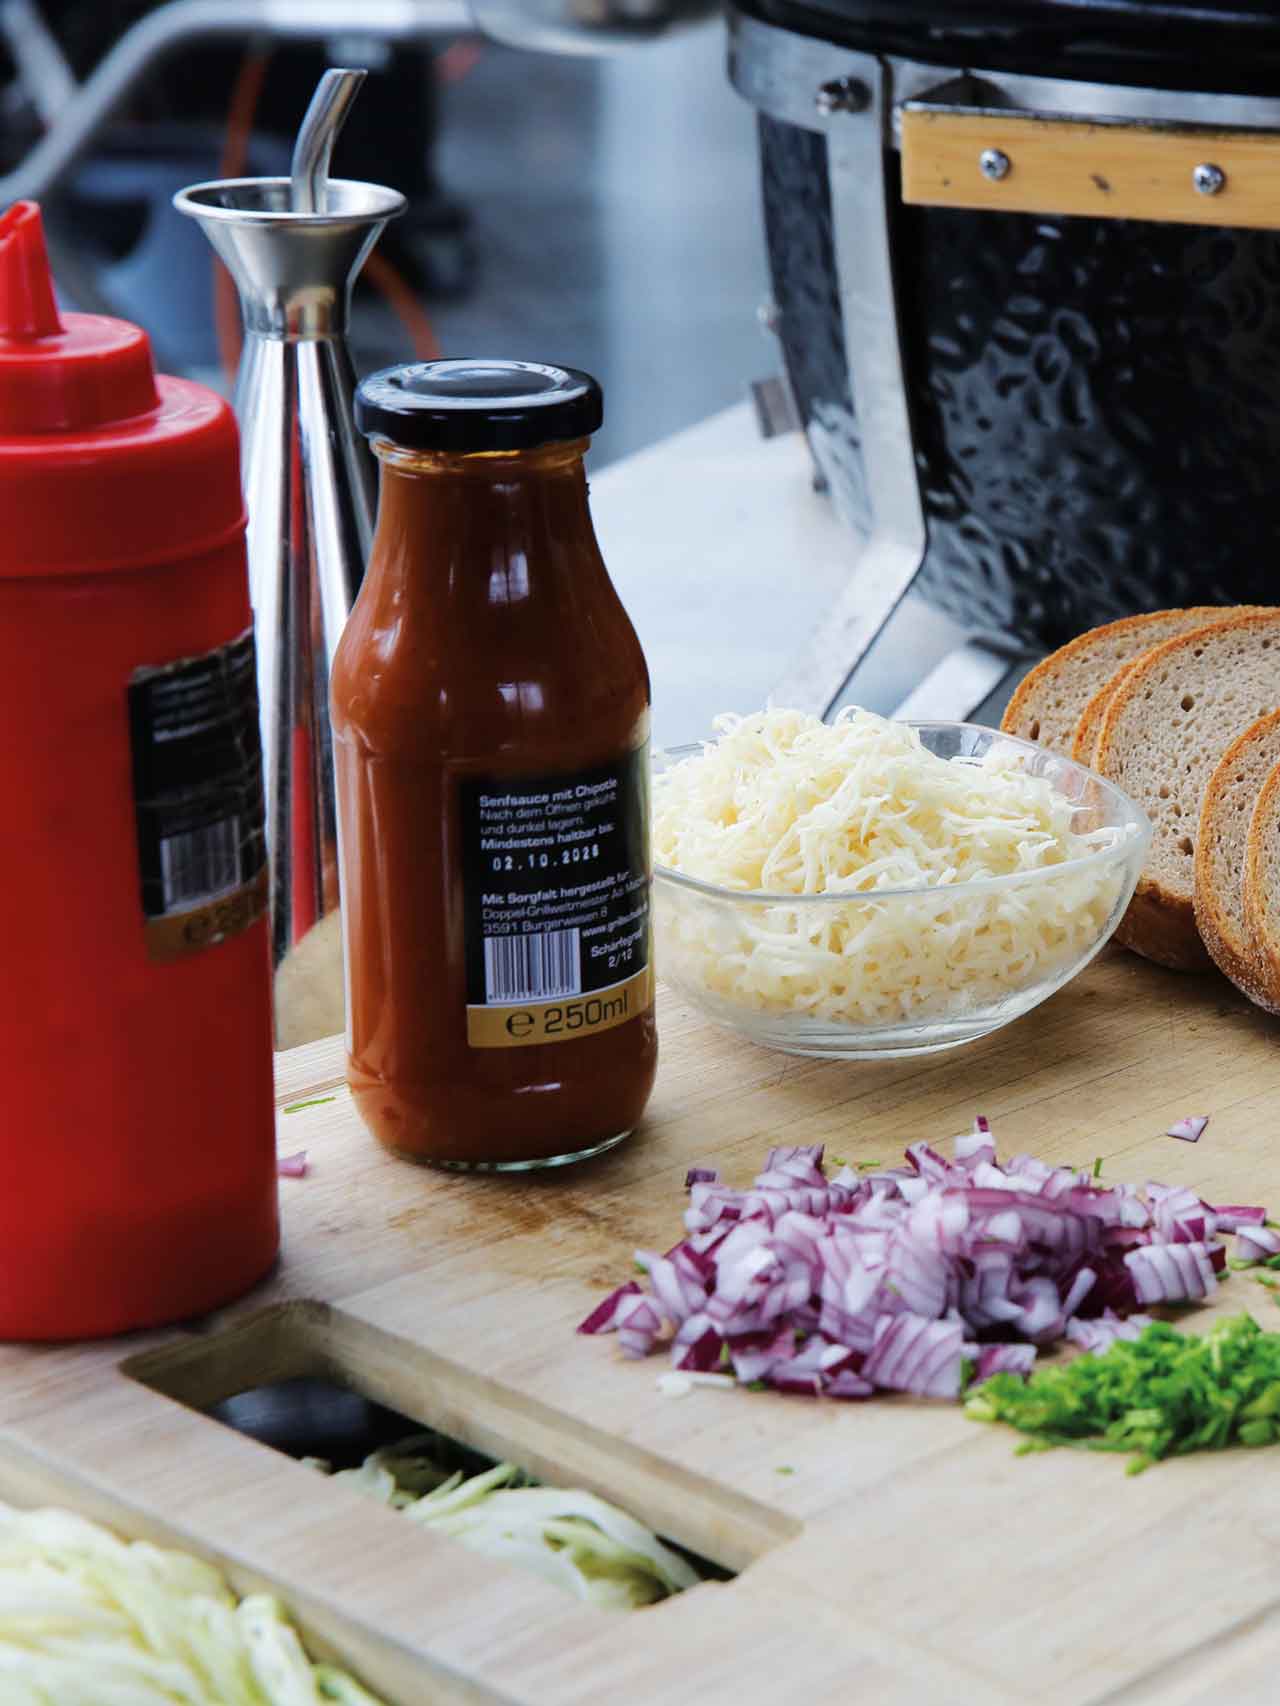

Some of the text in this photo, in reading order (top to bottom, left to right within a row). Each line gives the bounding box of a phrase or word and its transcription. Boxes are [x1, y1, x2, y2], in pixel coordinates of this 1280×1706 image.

[552, 790, 573, 802] mit
[480, 808, 512, 820] Nach
[516, 806, 542, 818] dem
[481, 823, 503, 835] und
[507, 820, 545, 834] dunkel
[481, 836, 554, 850] Mindestens
[557, 826, 596, 843] haltbar
[481, 893, 504, 905] Mit
[507, 889, 557, 905] Sorgfalt
[544, 989, 628, 1034] 250ml
